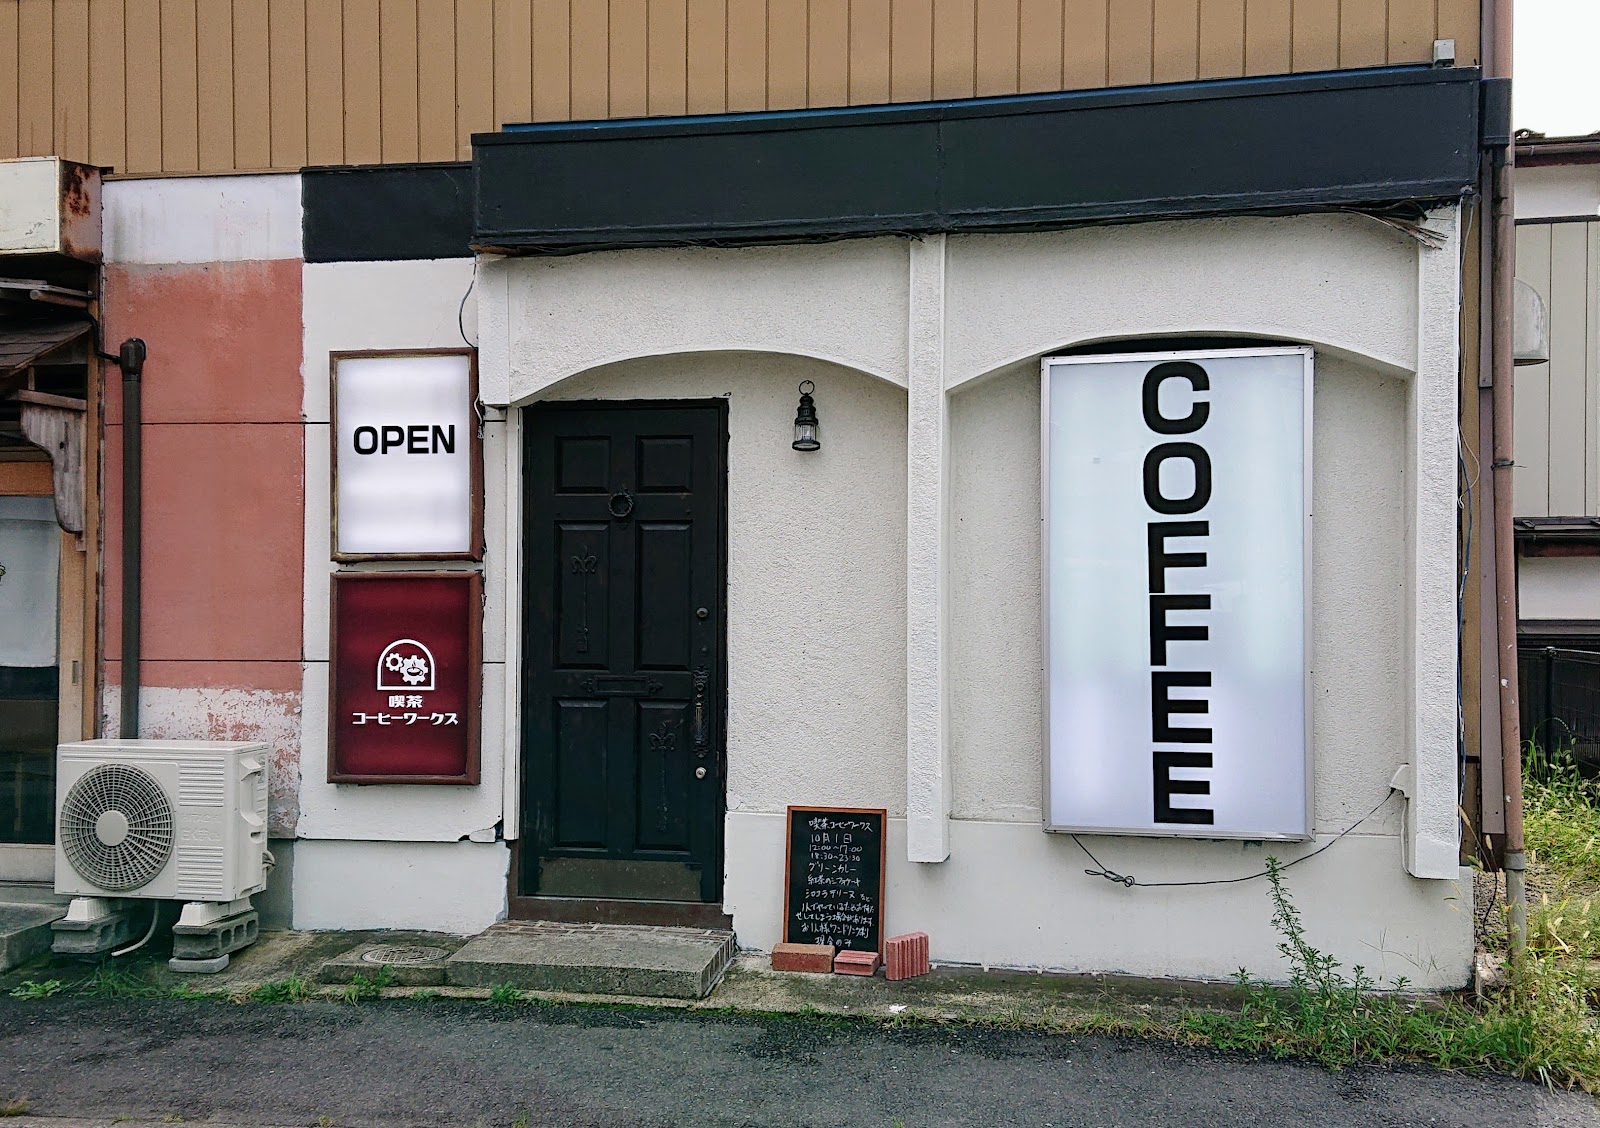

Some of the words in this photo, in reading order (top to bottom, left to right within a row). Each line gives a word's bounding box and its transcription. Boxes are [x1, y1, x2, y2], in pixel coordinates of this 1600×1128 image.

[353, 424, 455, 455] OPEN
[1142, 361, 1215, 825] COFFEE
[388, 695, 423, 709] 喫茶
[352, 712, 459, 726] コーヒーワークス
[808, 861, 857, 874] グリーンカレー
[815, 934, 852, 947] 現金のみ
